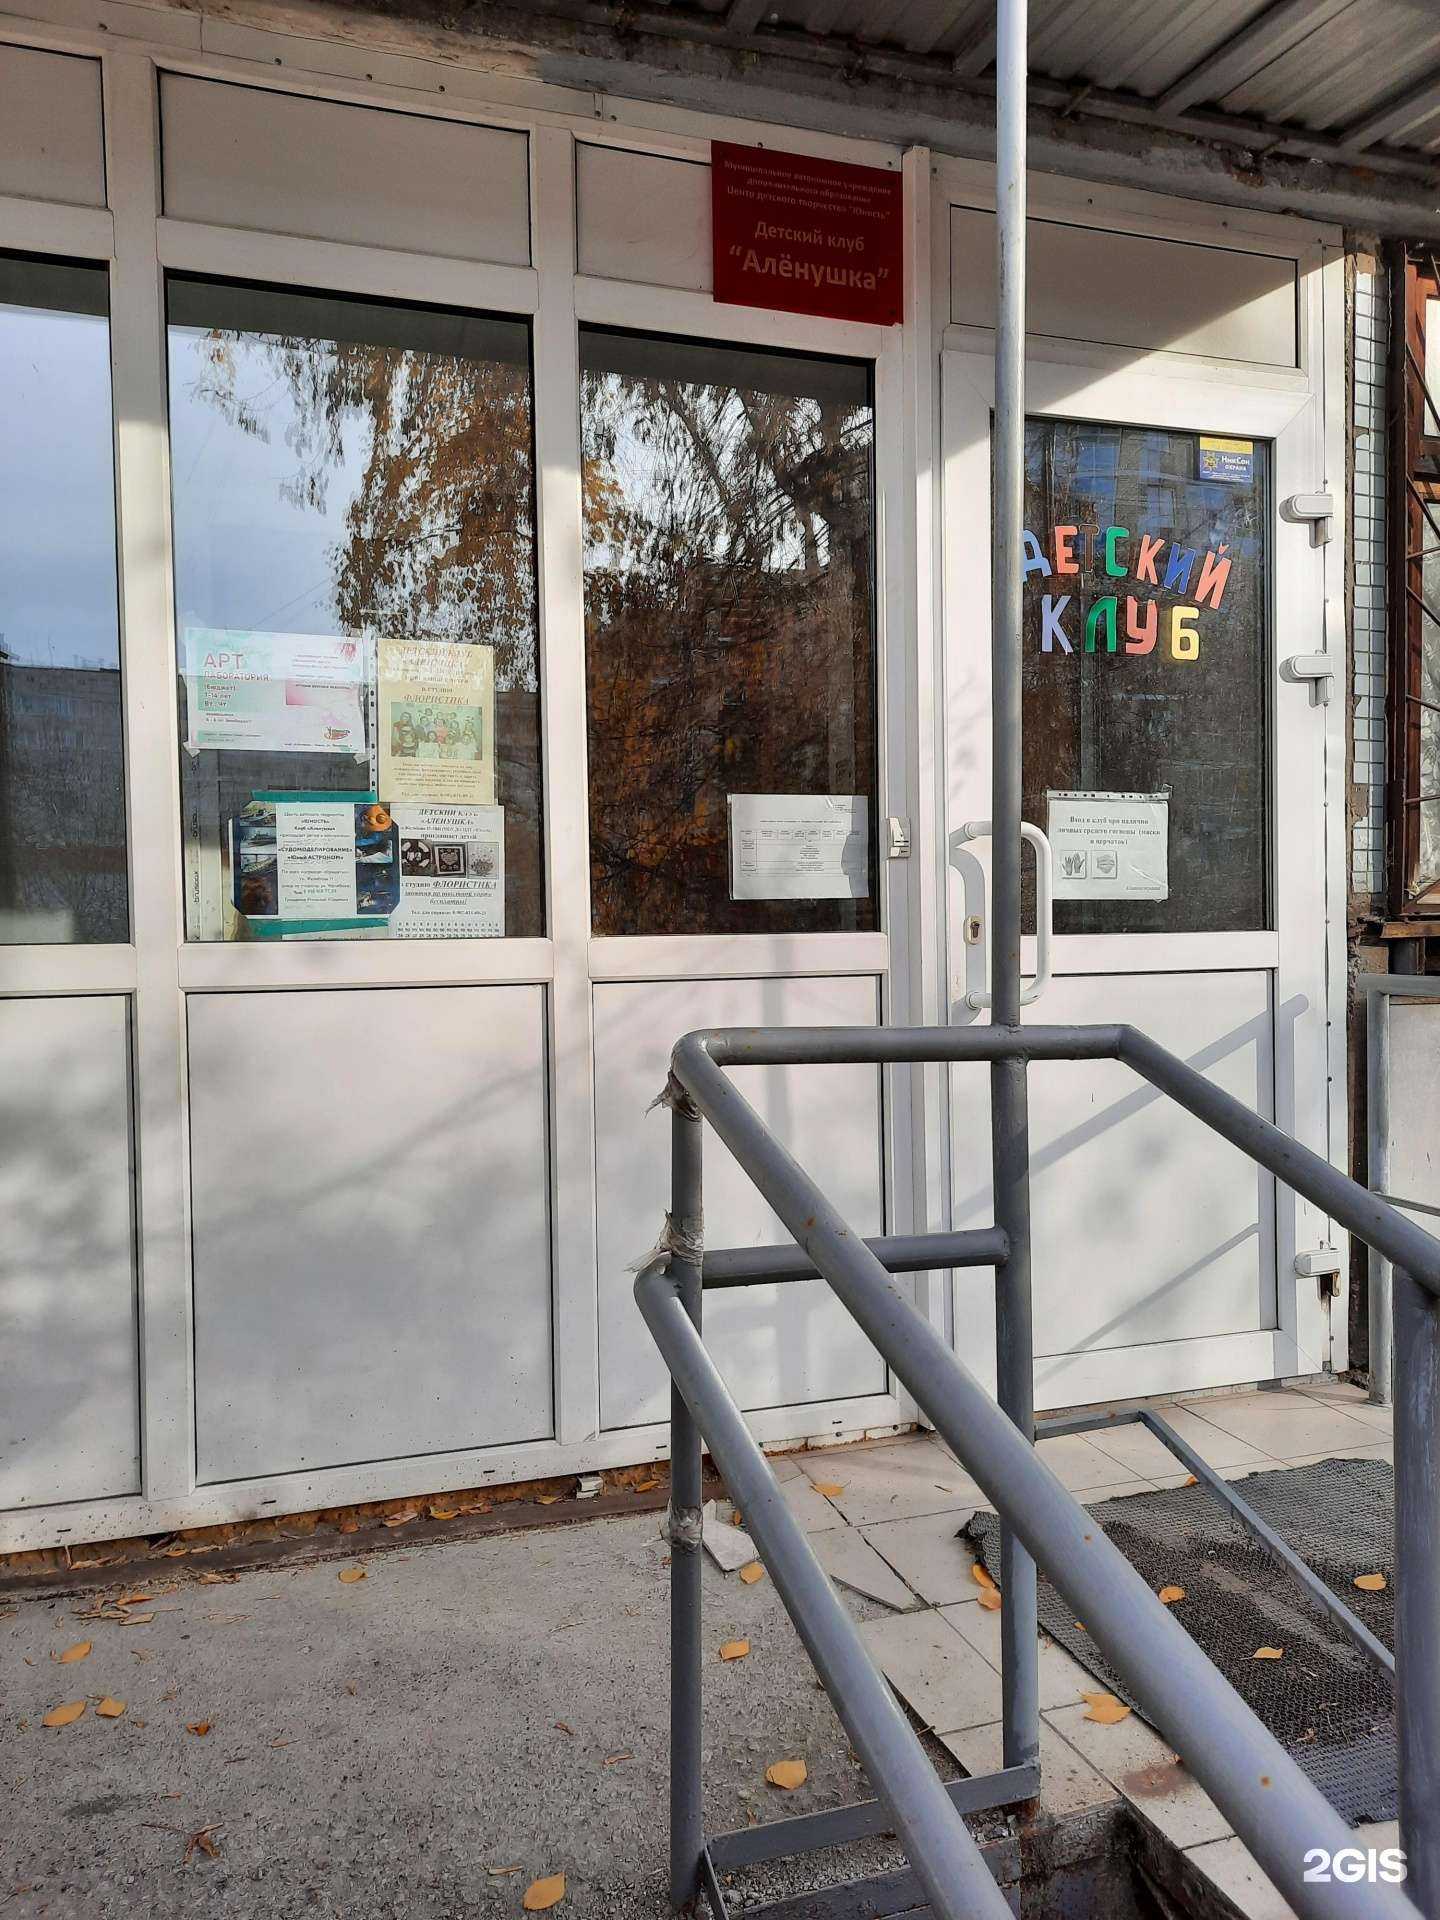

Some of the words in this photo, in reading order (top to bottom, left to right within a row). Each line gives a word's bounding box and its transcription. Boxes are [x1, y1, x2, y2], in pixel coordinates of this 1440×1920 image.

[727, 185, 755, 200] Центр
[756, 191, 796, 206] детского
[798, 199, 847, 213] творчества
[754, 221, 823, 246] Детский
[828, 233, 865, 254] клуб
[1041, 594, 1200, 660] КЛУБ
[204, 653, 244, 670] АРТ
[432, 880, 496, 889] ФЛОРИСТИКА
